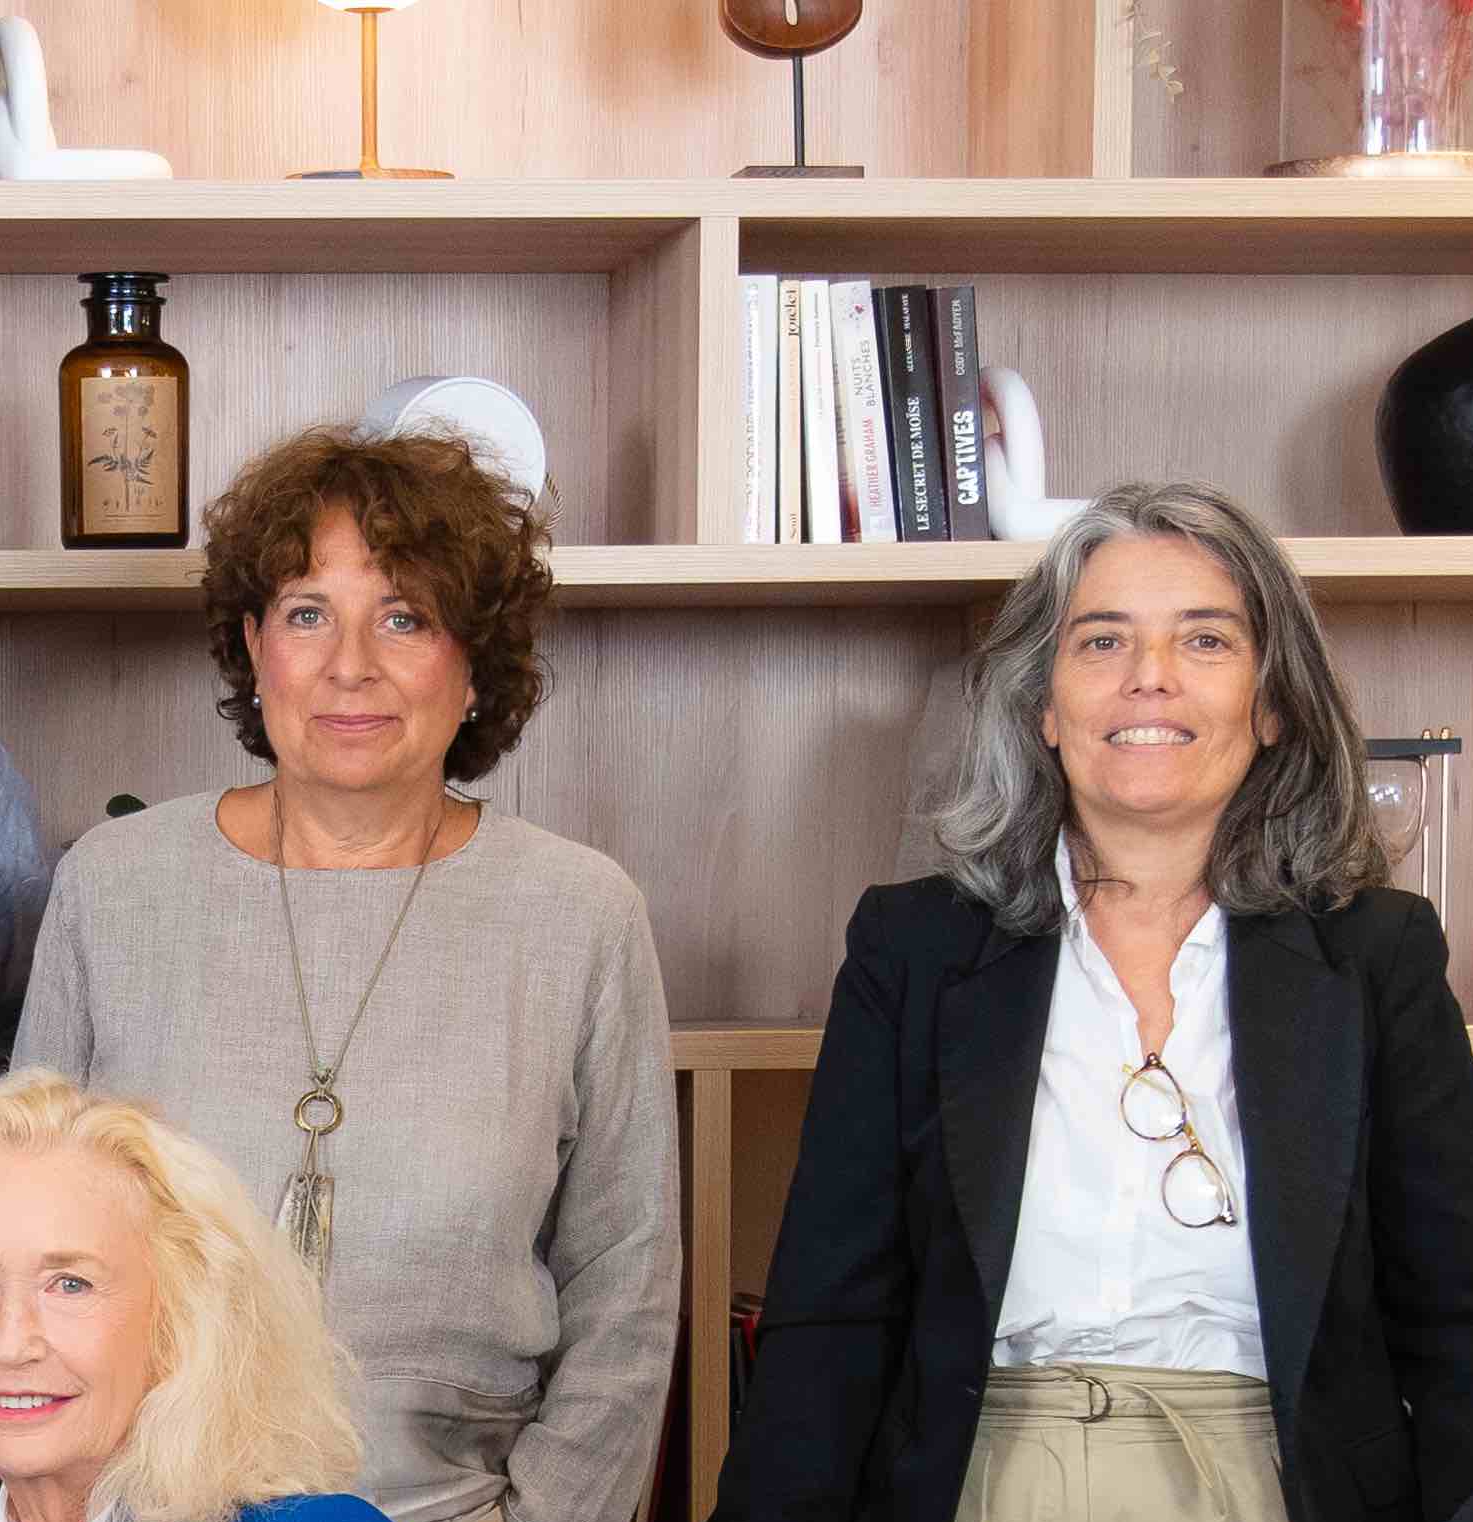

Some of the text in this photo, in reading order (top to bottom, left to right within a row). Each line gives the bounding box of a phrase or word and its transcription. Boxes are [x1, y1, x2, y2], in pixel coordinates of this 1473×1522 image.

[853, 356, 863, 396] NUITS
[861, 338, 877, 407] BLANCHES
[954, 350, 966, 376] CODY
[862, 416, 881, 508] HEATHER GRAHAM
[906, 396, 929, 531] LE SECRET DE MOÏSE
[953, 409, 980, 505] CAPTIVES
